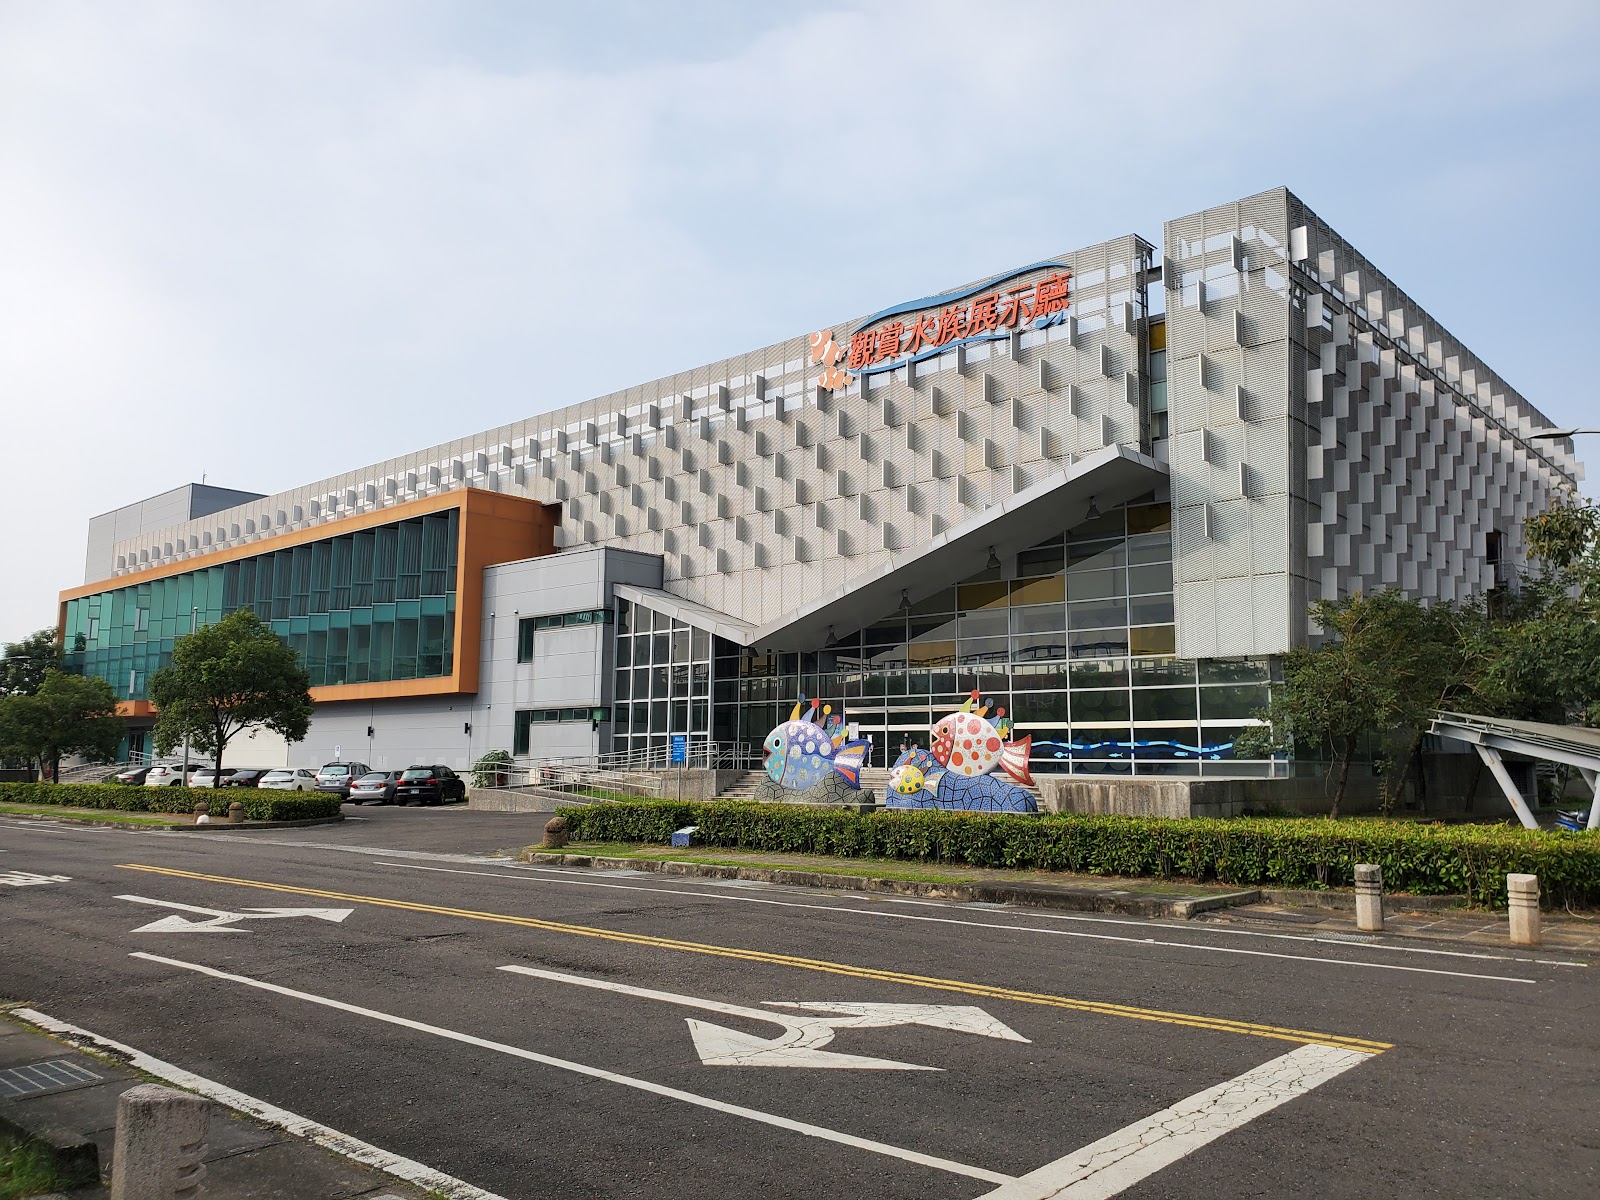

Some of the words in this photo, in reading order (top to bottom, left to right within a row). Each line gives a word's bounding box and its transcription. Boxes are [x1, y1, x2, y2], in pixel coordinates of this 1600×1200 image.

[848, 272, 1071, 370] 觀賞水族展示廳
